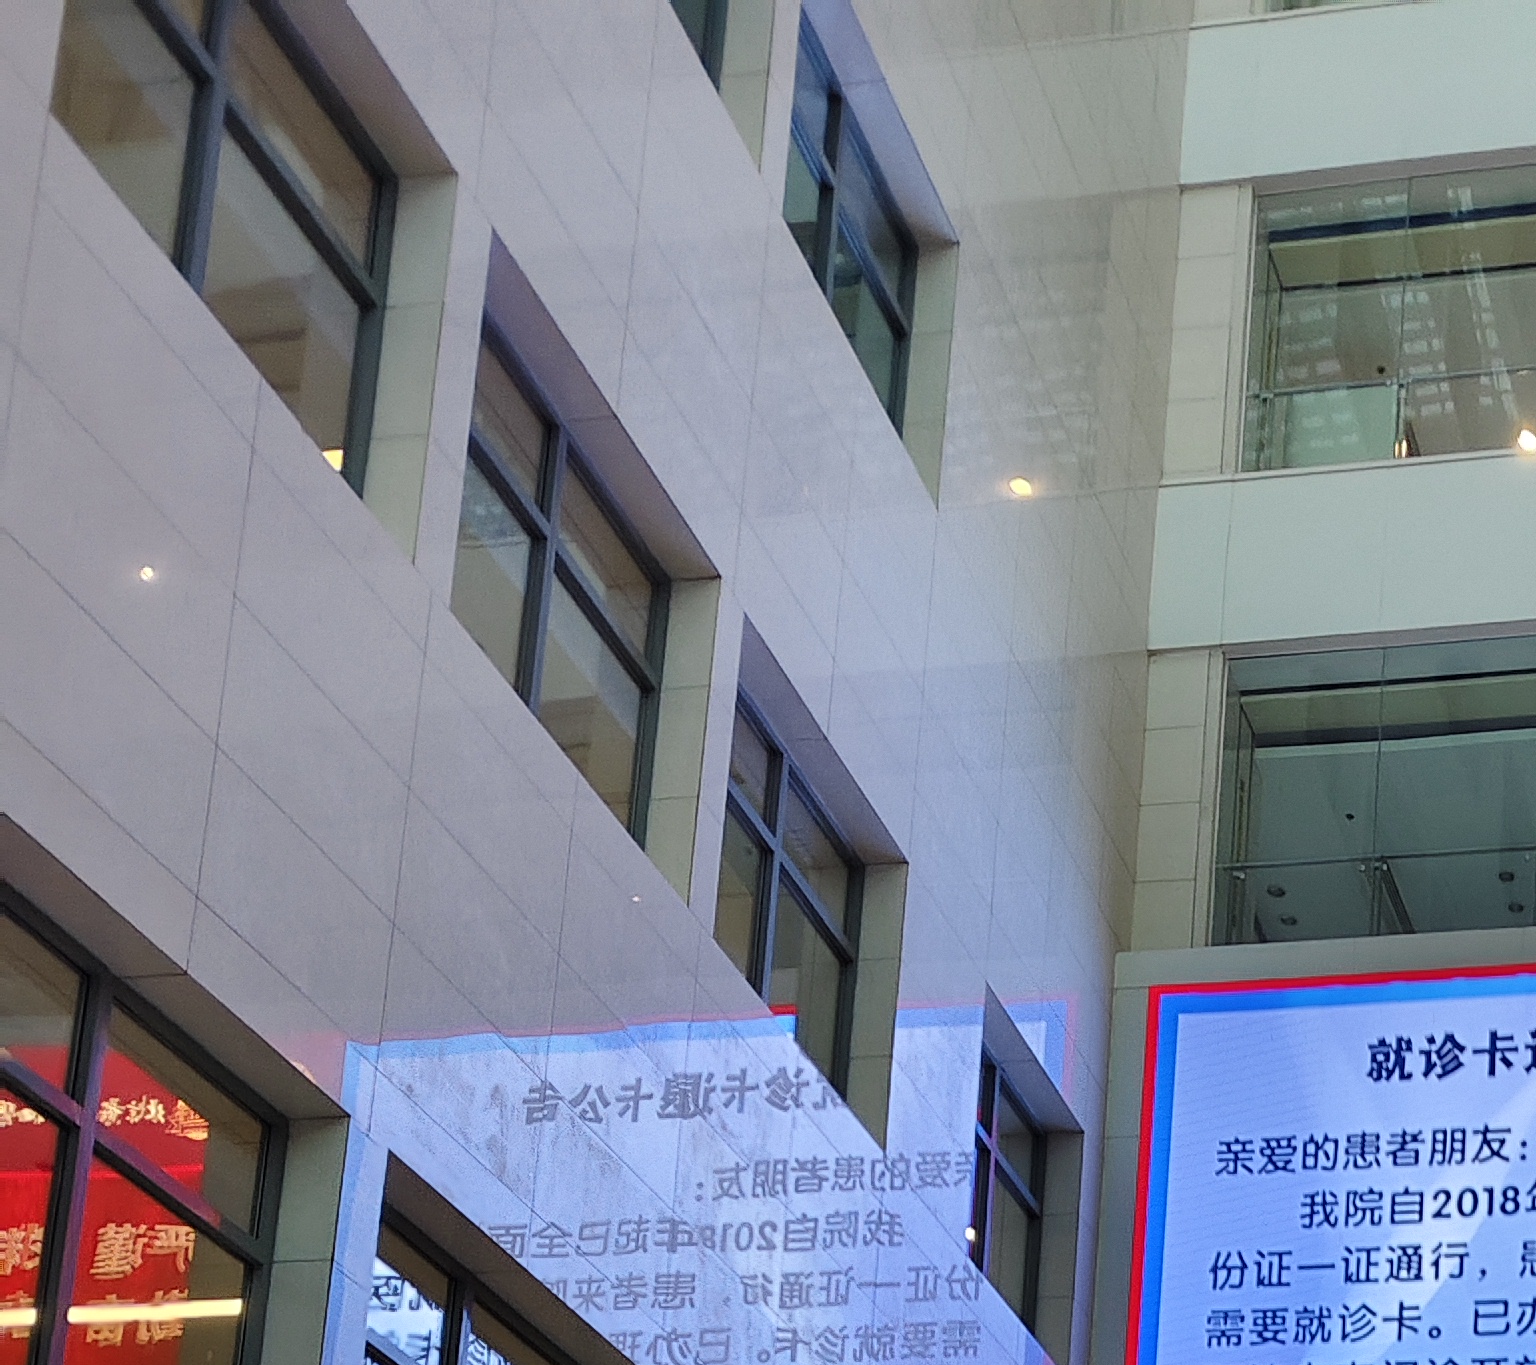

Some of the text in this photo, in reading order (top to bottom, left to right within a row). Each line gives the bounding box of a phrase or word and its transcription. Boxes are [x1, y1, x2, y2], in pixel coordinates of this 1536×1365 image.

[1215, 1124, 1531, 1177] 亲爱的患者朋友：
